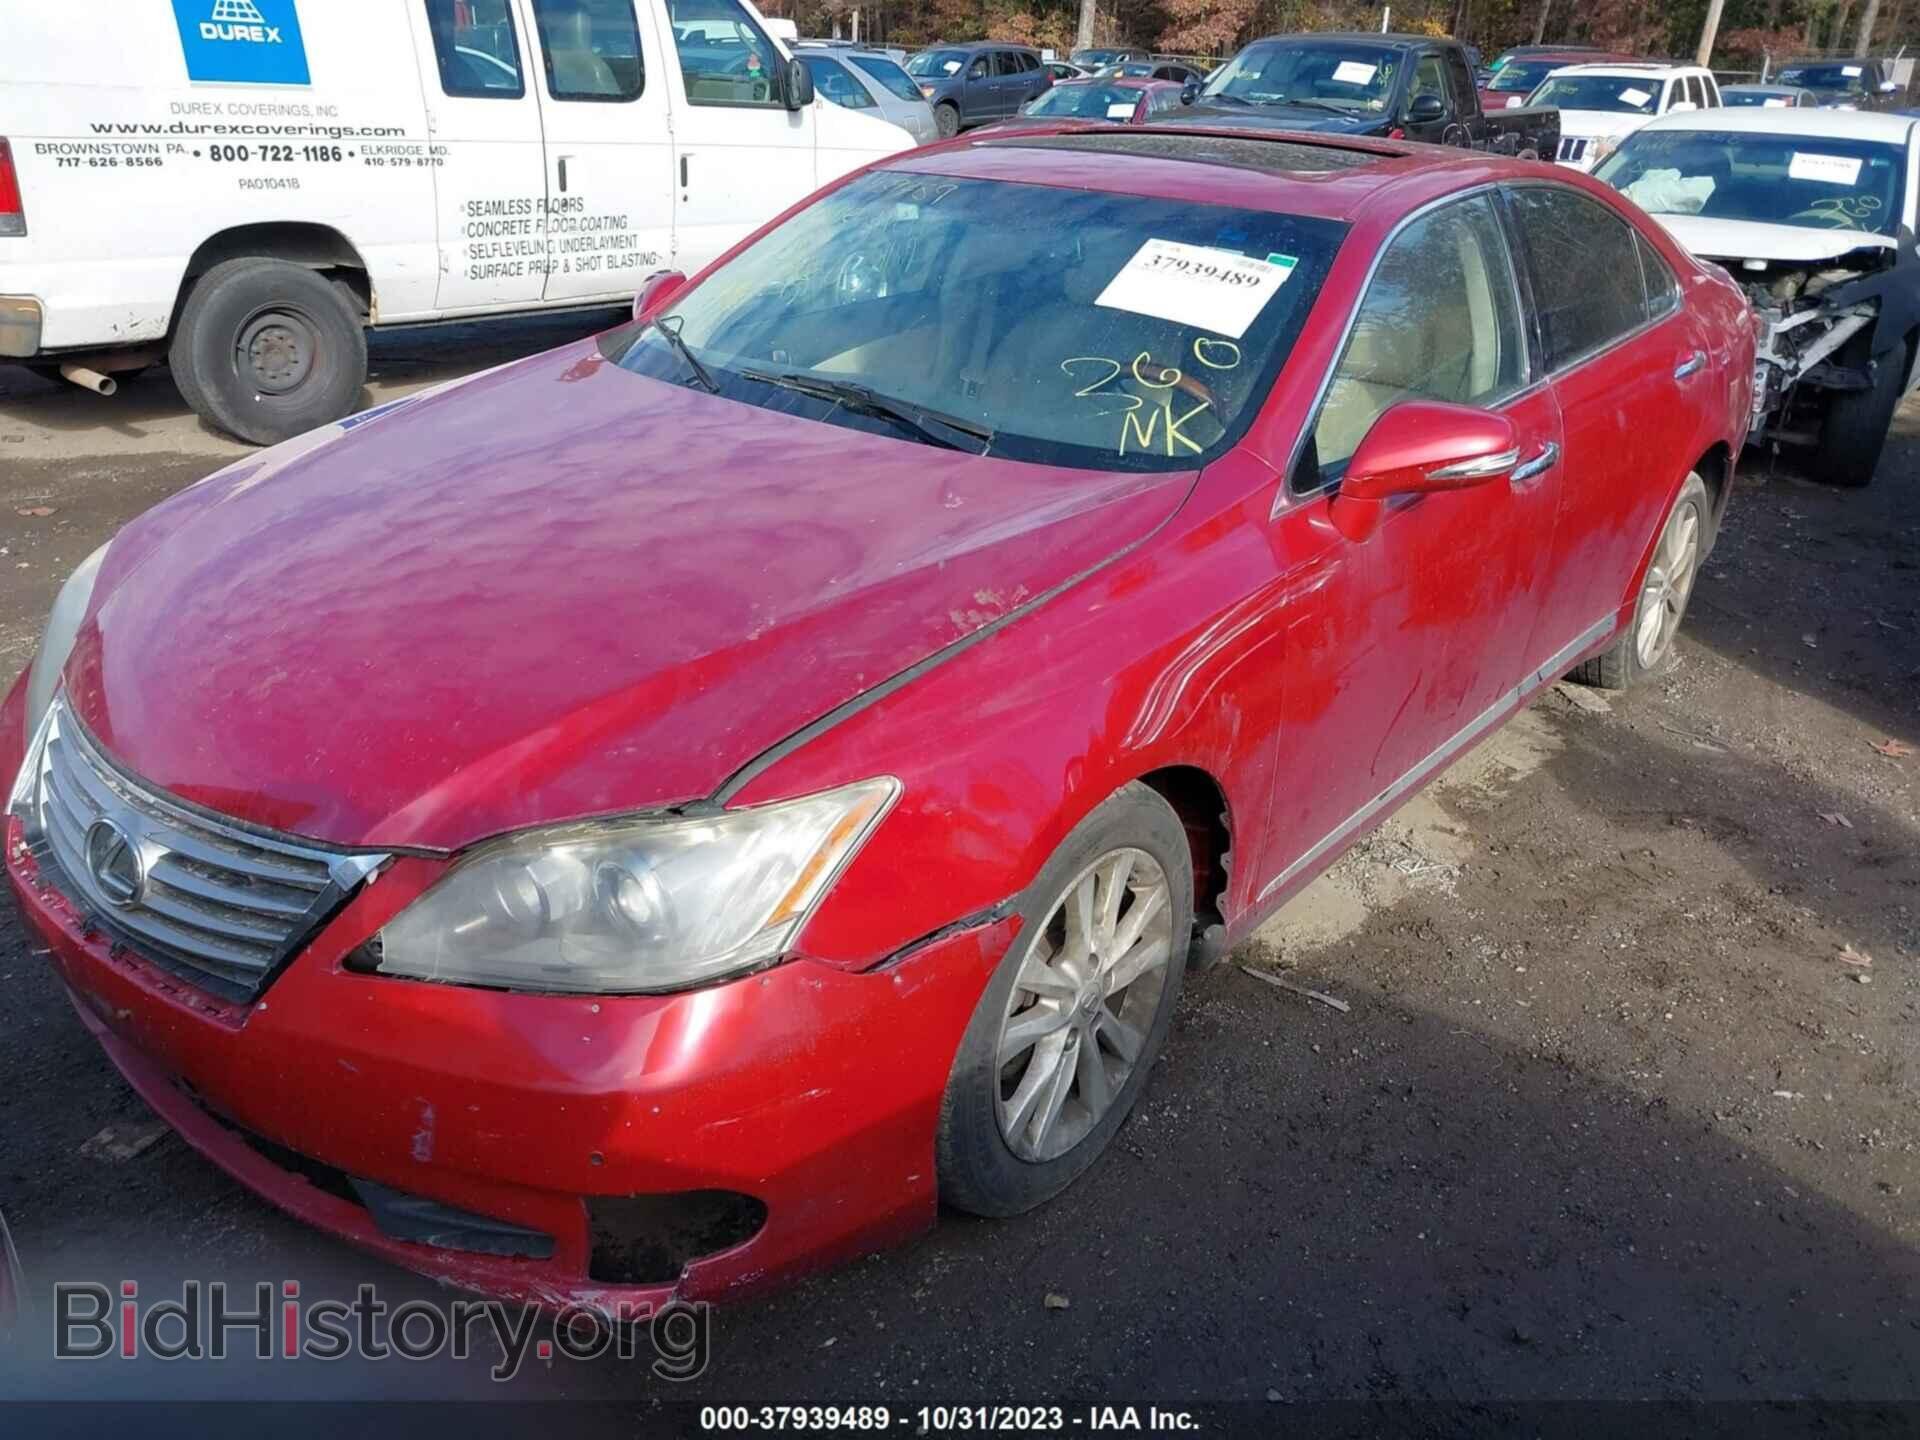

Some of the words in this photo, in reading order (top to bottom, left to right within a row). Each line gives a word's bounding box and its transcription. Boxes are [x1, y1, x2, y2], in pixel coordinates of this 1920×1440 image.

[199, 22, 282, 43] DUREX
[170, 102, 223, 115] DUREX
[316, 106, 338, 117] INC
[91, 122, 405, 139] www.durexcoverings.com
[35, 143, 159, 155] BROWNSTOWN
[209, 145, 342, 162] 800-722-1186
[360, 145, 423, 156] ELKRIDGE
[56, 157, 163, 167] 717-626-8566
[467, 199, 532, 217] SEAMLESS
[536, 197, 584, 214] FLOORS
[467, 219, 531, 238] CONCRETE
[580, 215, 628, 232] COATING
[559, 234, 638, 254] UNDERLAYMENT
[469, 261, 523, 280] SURFACE
[528, 259, 559, 275] PREP
[575, 255, 602, 273] SHOT
[607, 251, 657, 270] BLASTING
[1143, 254, 1260, 288] 37939489
